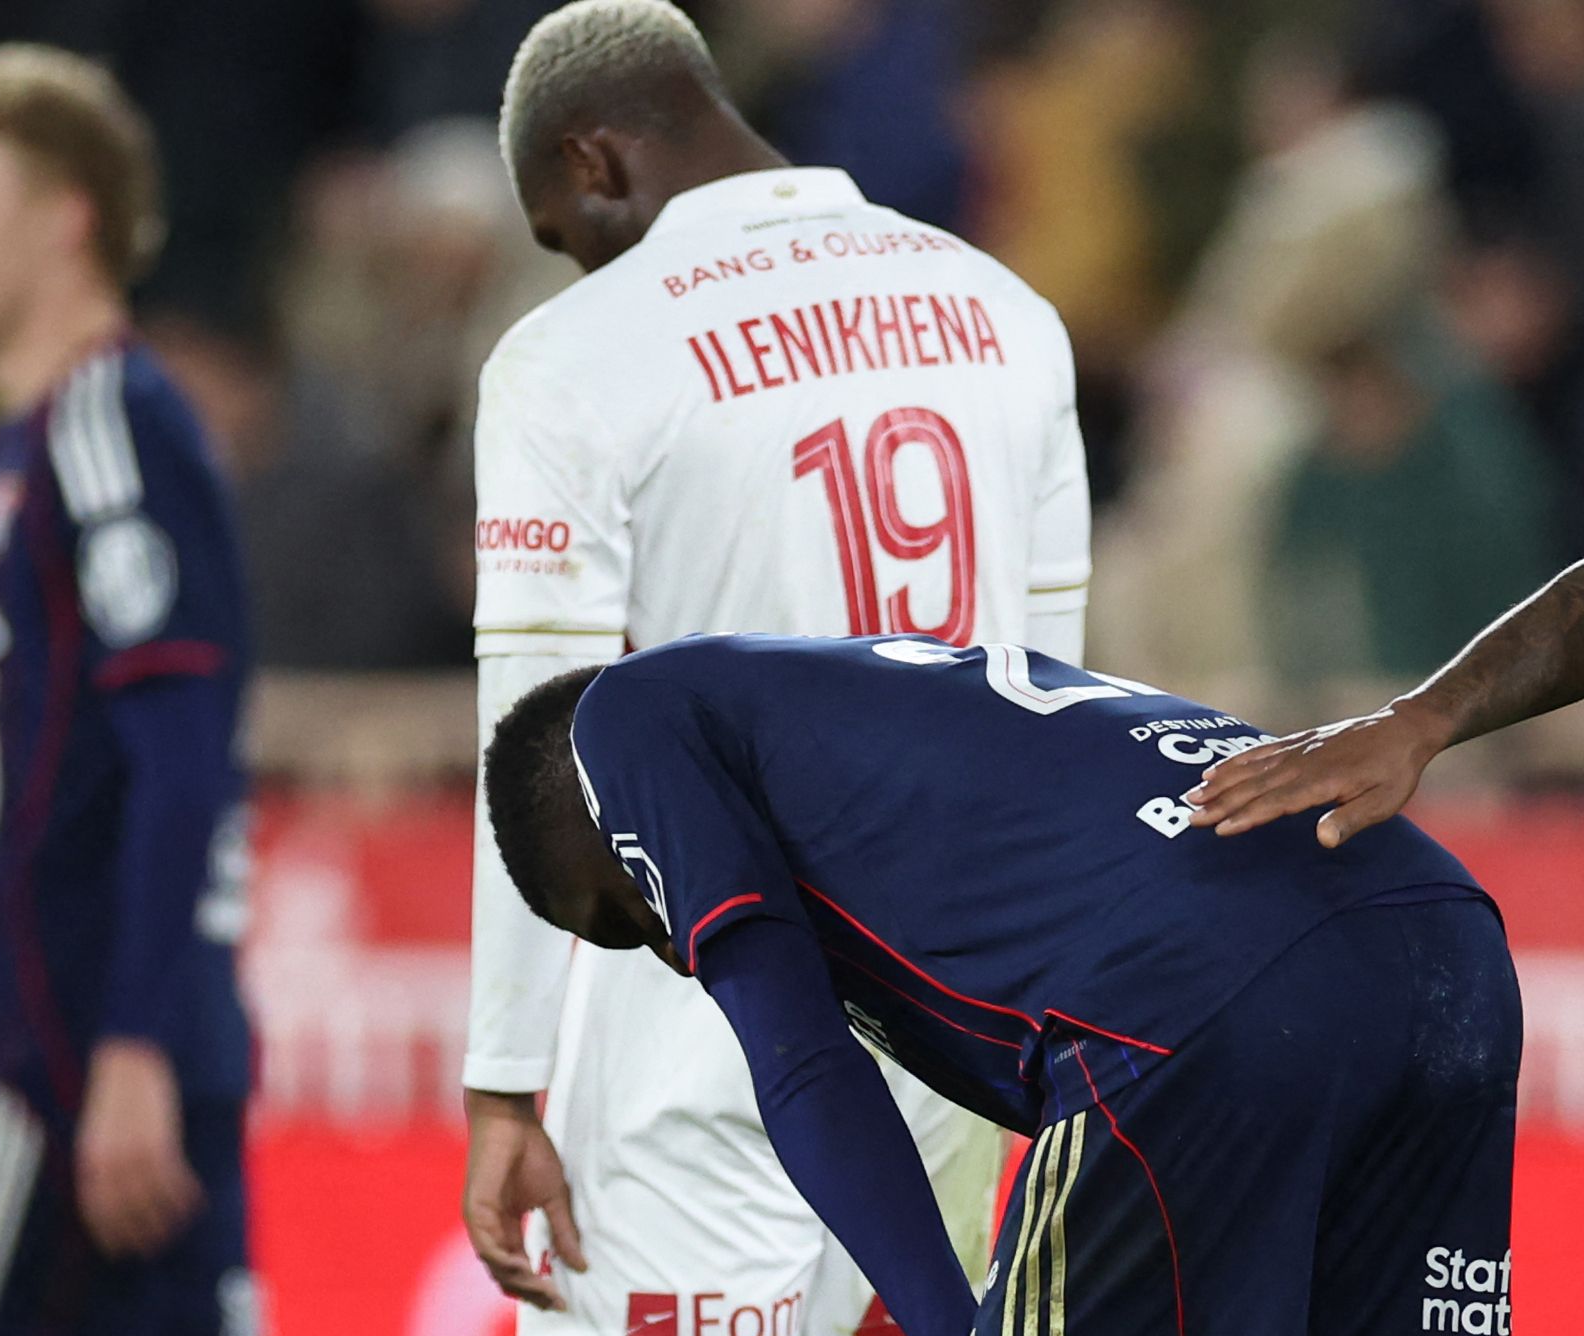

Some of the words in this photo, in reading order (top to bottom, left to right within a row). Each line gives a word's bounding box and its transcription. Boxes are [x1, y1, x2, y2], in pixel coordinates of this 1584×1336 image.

[662, 248, 776, 299] BANG
[789, 239, 817, 264] &
[687, 293, 1006, 403] ILENIKHENA
[792, 406, 976, 649] 19
[1422, 1294, 1513, 1336] mat
